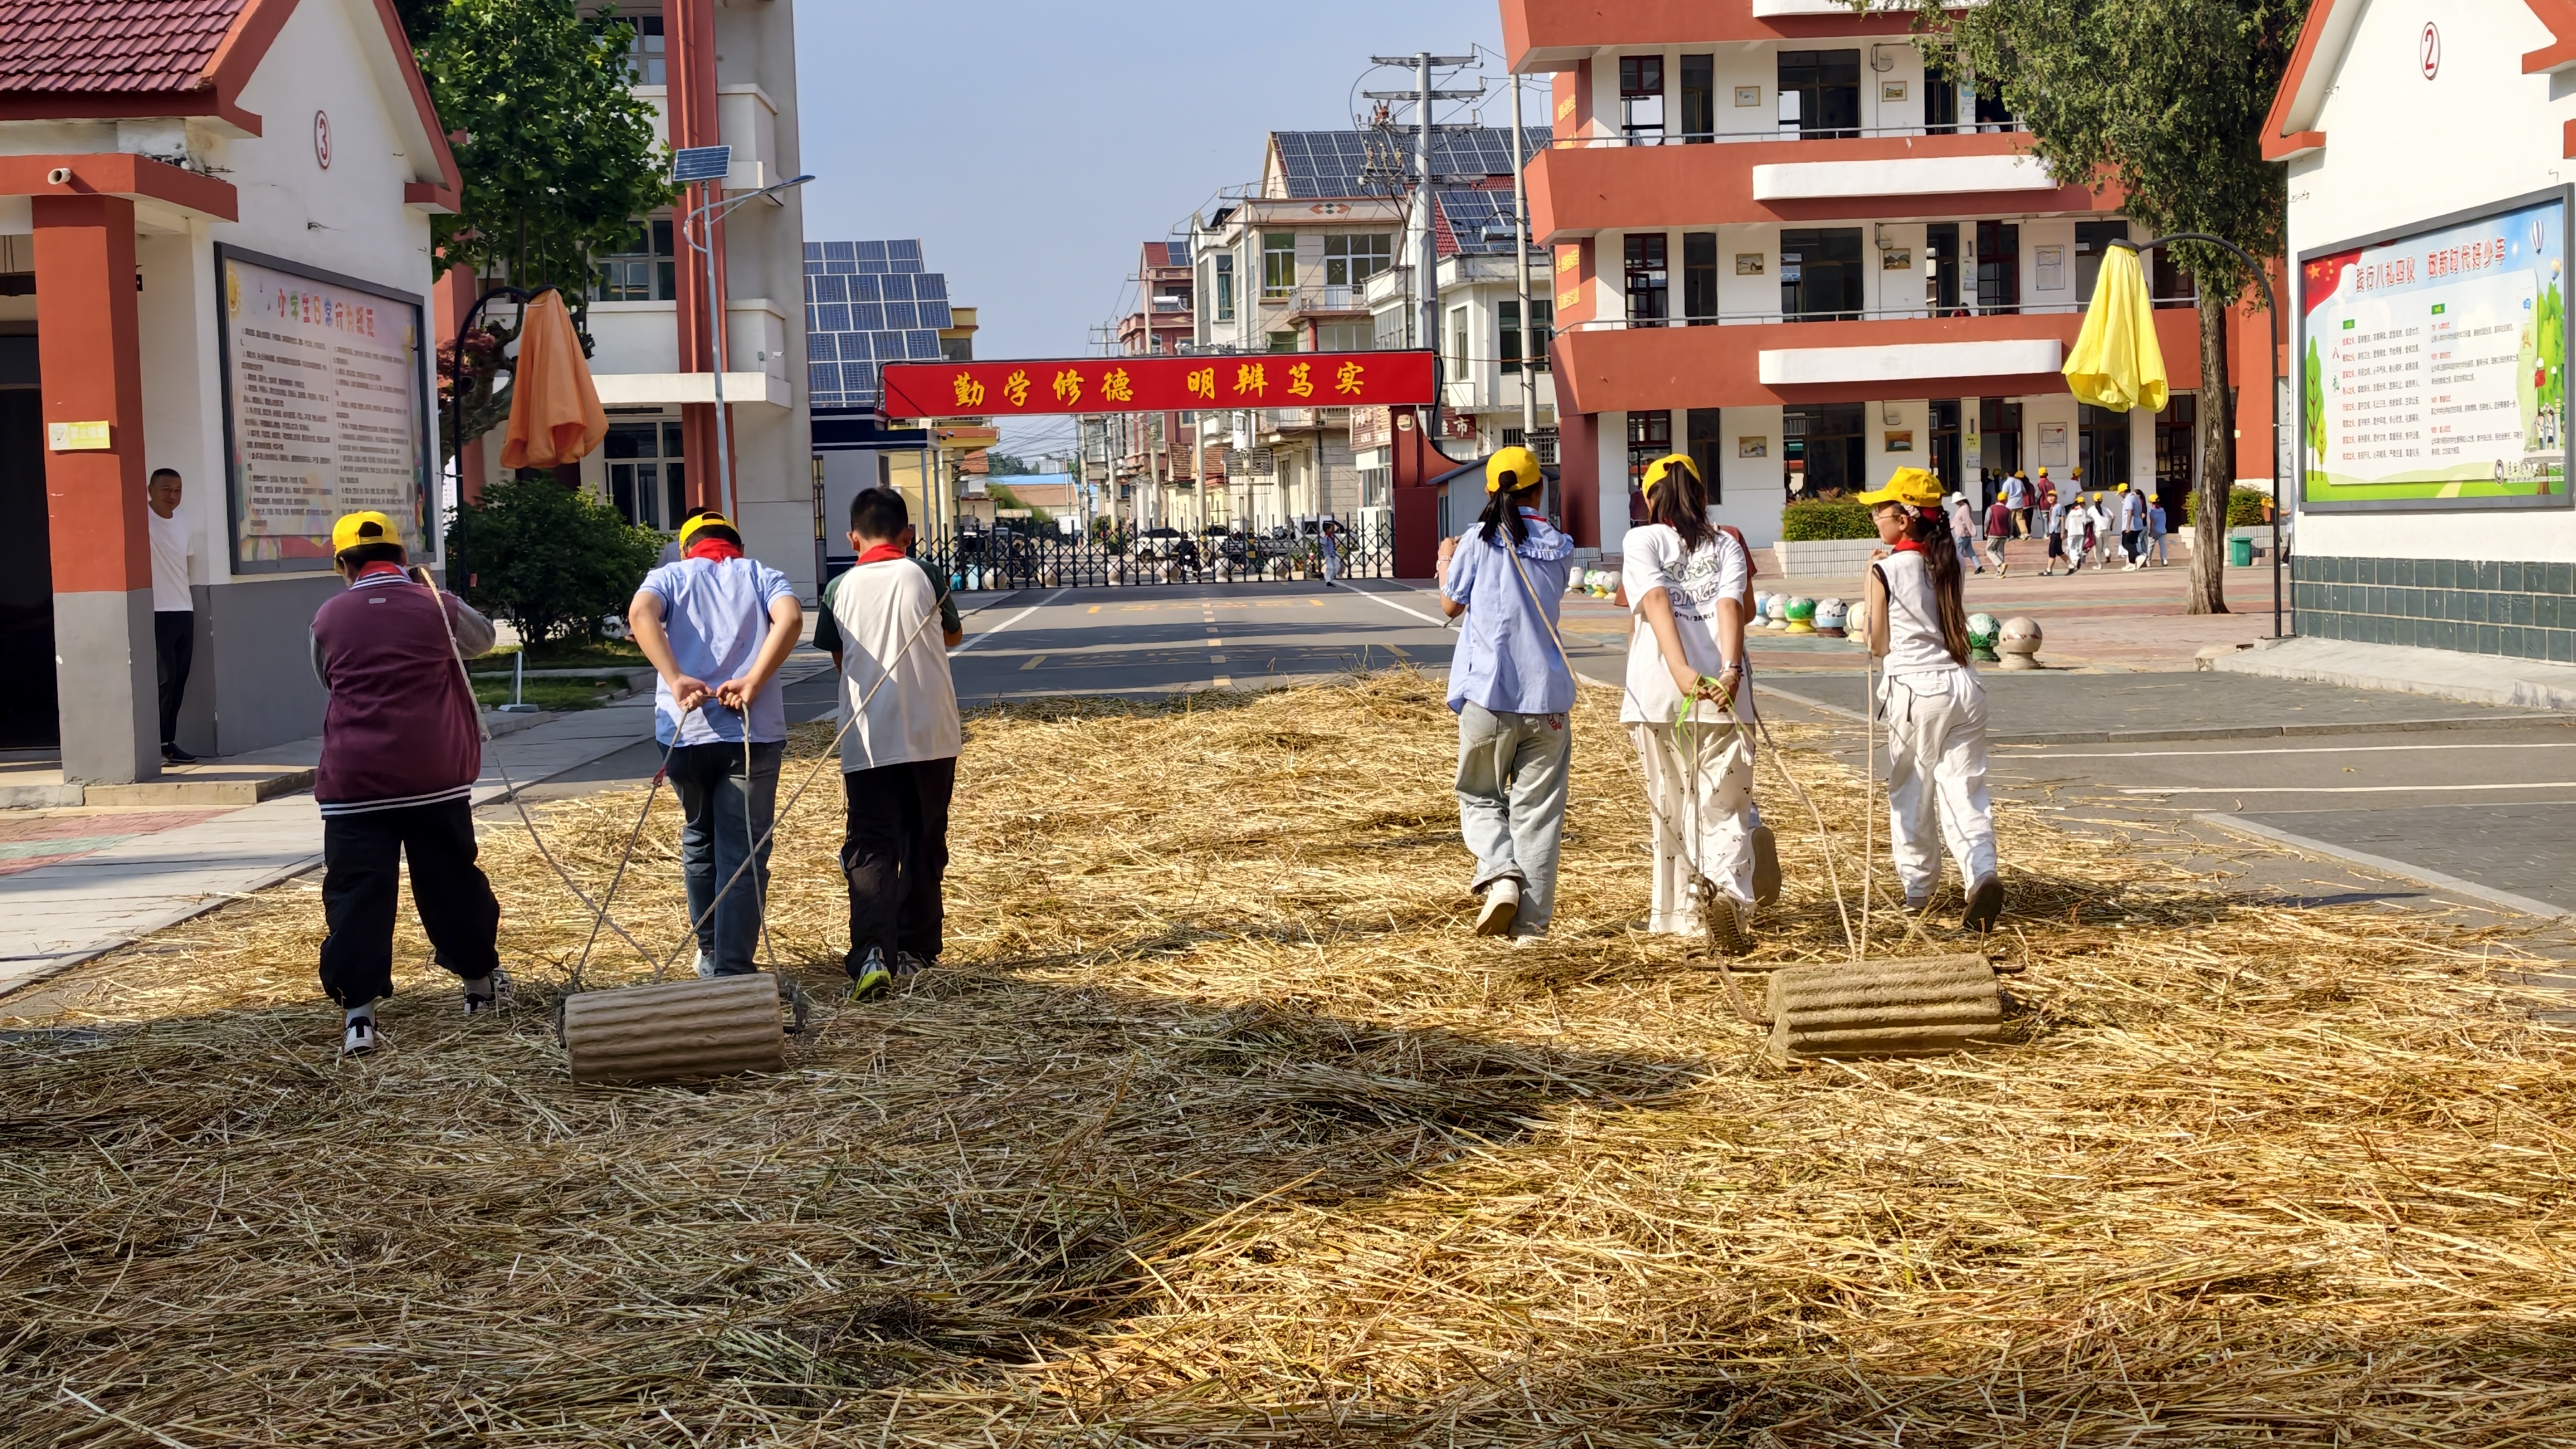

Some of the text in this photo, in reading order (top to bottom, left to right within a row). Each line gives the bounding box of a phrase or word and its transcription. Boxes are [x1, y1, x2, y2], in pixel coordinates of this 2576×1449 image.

[2425, 28, 2434, 70] 2
[319, 117, 328, 160] 3
[953, 361, 1365, 408] 勤学修德 明辨笃实
[1668, 581, 1718, 607] DANCE
